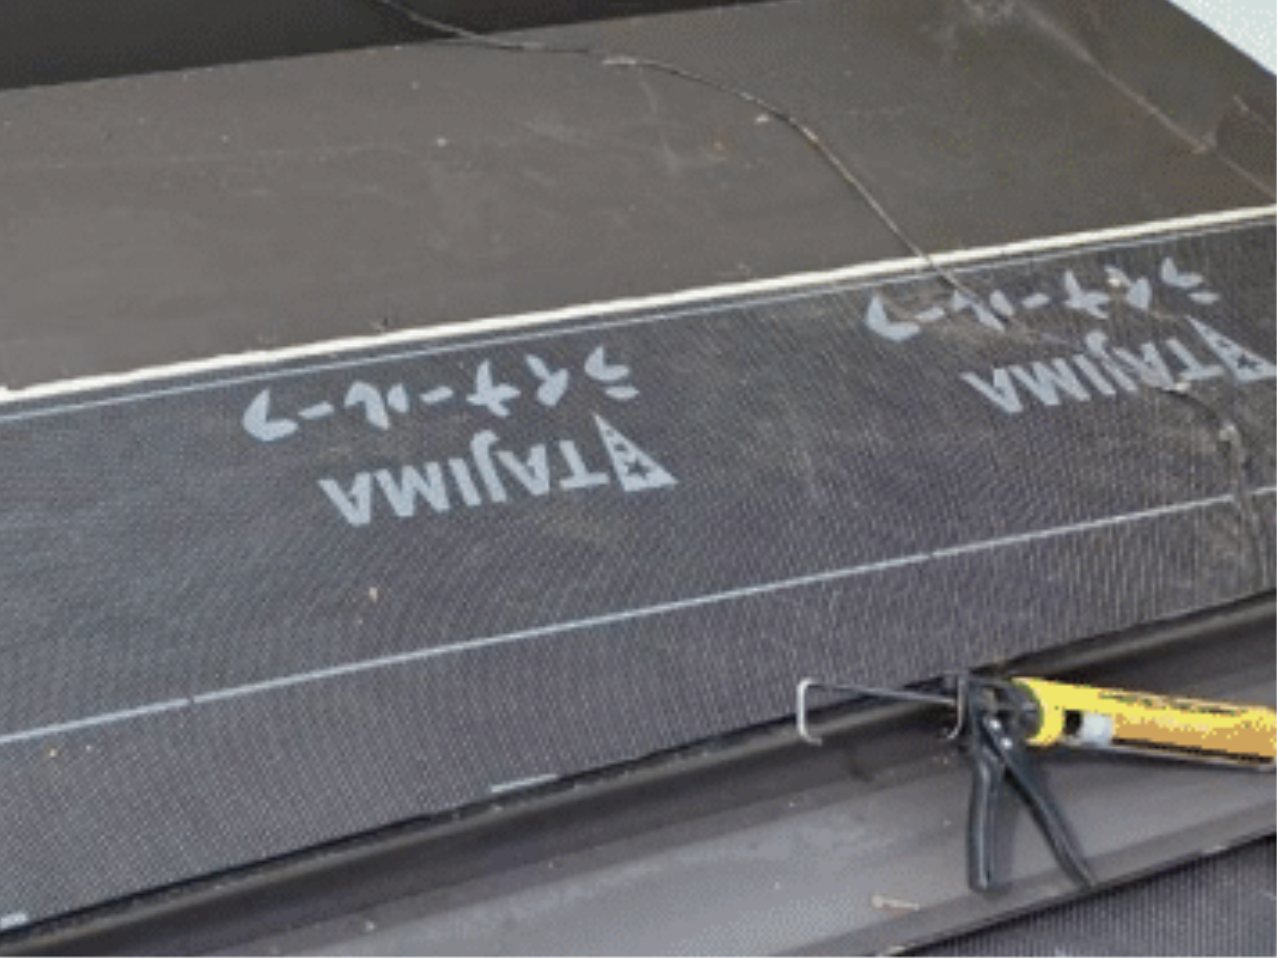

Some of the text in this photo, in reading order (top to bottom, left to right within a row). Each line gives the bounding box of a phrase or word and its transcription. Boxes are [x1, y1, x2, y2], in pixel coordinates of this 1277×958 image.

[241, 345, 640, 442] ライナールーフ
[960, 329, 1224, 414] TAJIMA
[317, 429, 610, 527] TAJIMA
